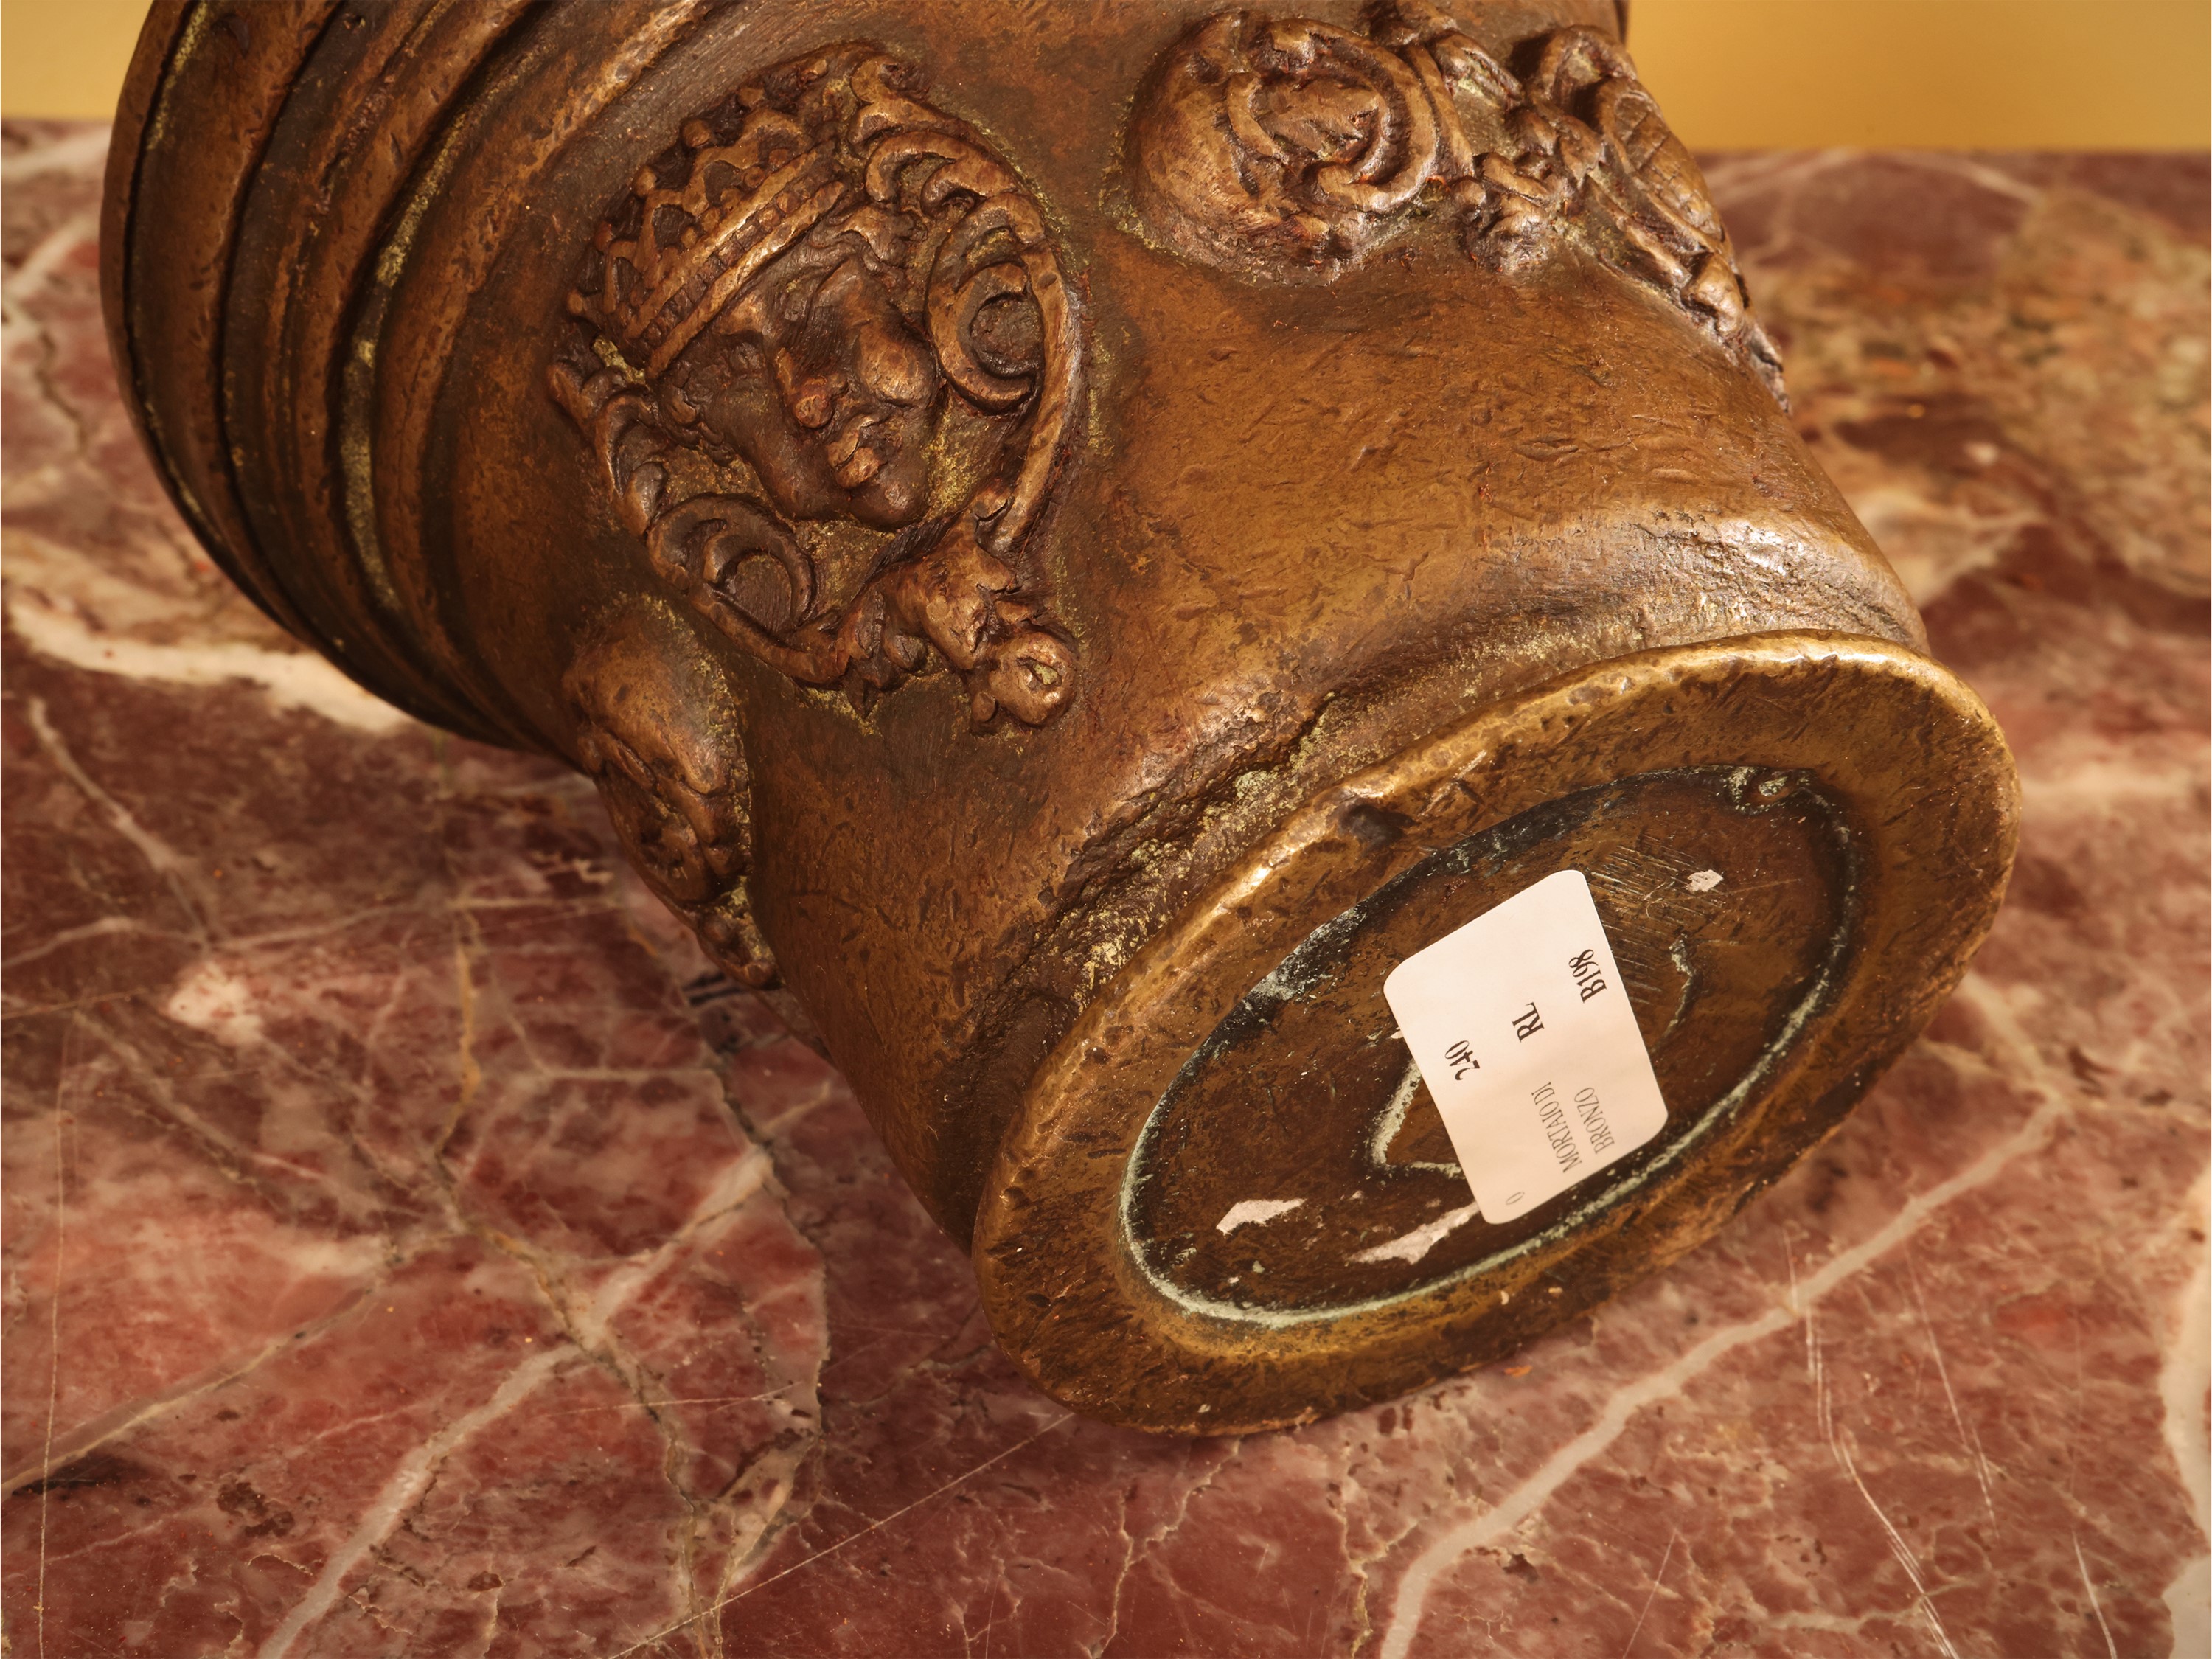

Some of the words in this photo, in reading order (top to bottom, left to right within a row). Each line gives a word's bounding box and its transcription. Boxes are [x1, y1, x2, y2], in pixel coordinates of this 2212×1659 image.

[1568, 948, 1608, 1004] B198
[1511, 1001, 1545, 1043] RL
[1444, 1040, 1481, 1082] 240
[1531, 1081, 1556, 1106] DI
[1538, 1100, 1583, 1174] MORTAIO
[1573, 1086, 1615, 1155] BRONZO
